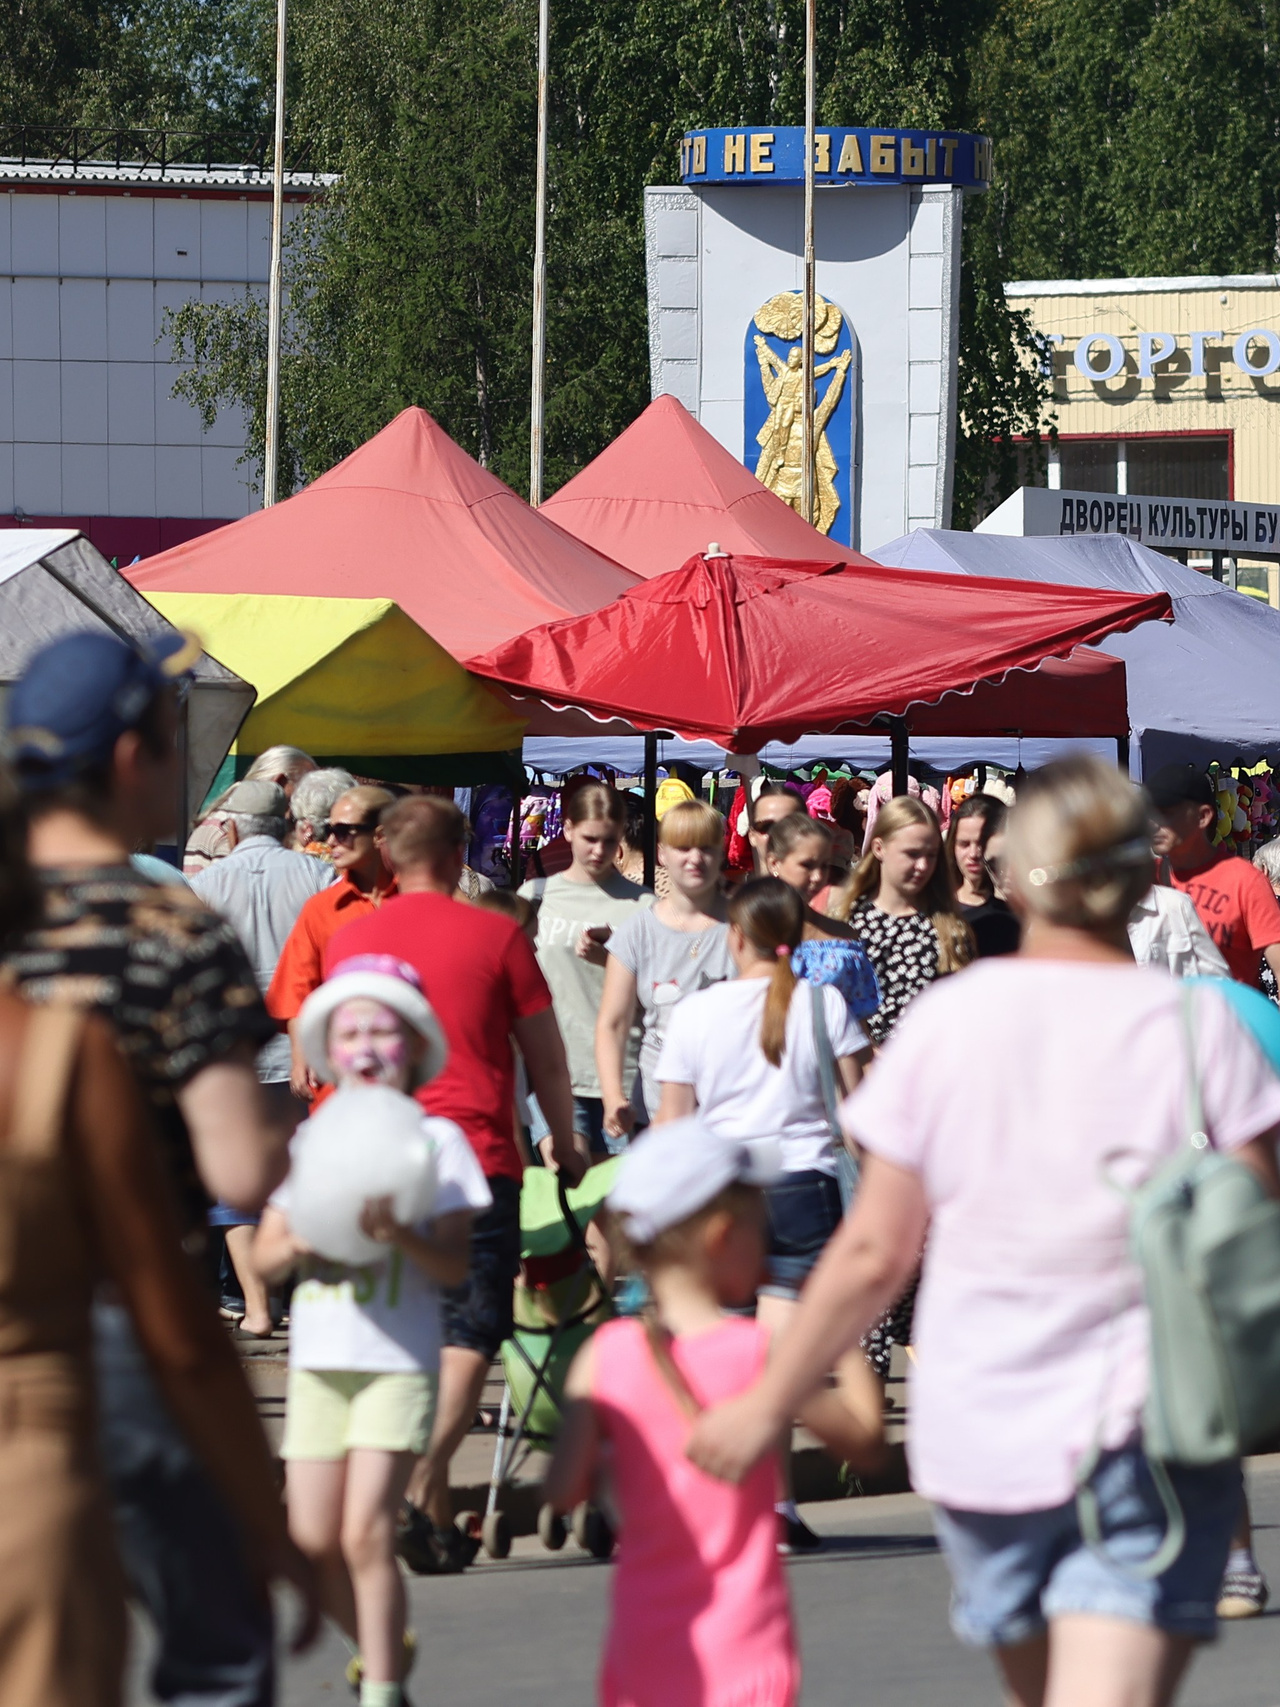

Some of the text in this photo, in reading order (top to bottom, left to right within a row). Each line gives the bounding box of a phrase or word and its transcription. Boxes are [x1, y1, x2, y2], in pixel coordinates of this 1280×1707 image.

[724, 132, 775, 173] НЕ
[804, 134, 958, 177] ЗАБЫТ
[1059, 497, 1143, 542] ДВОРЕЦ
[1148, 503, 1249, 542] КУЛЬТУРЫ
